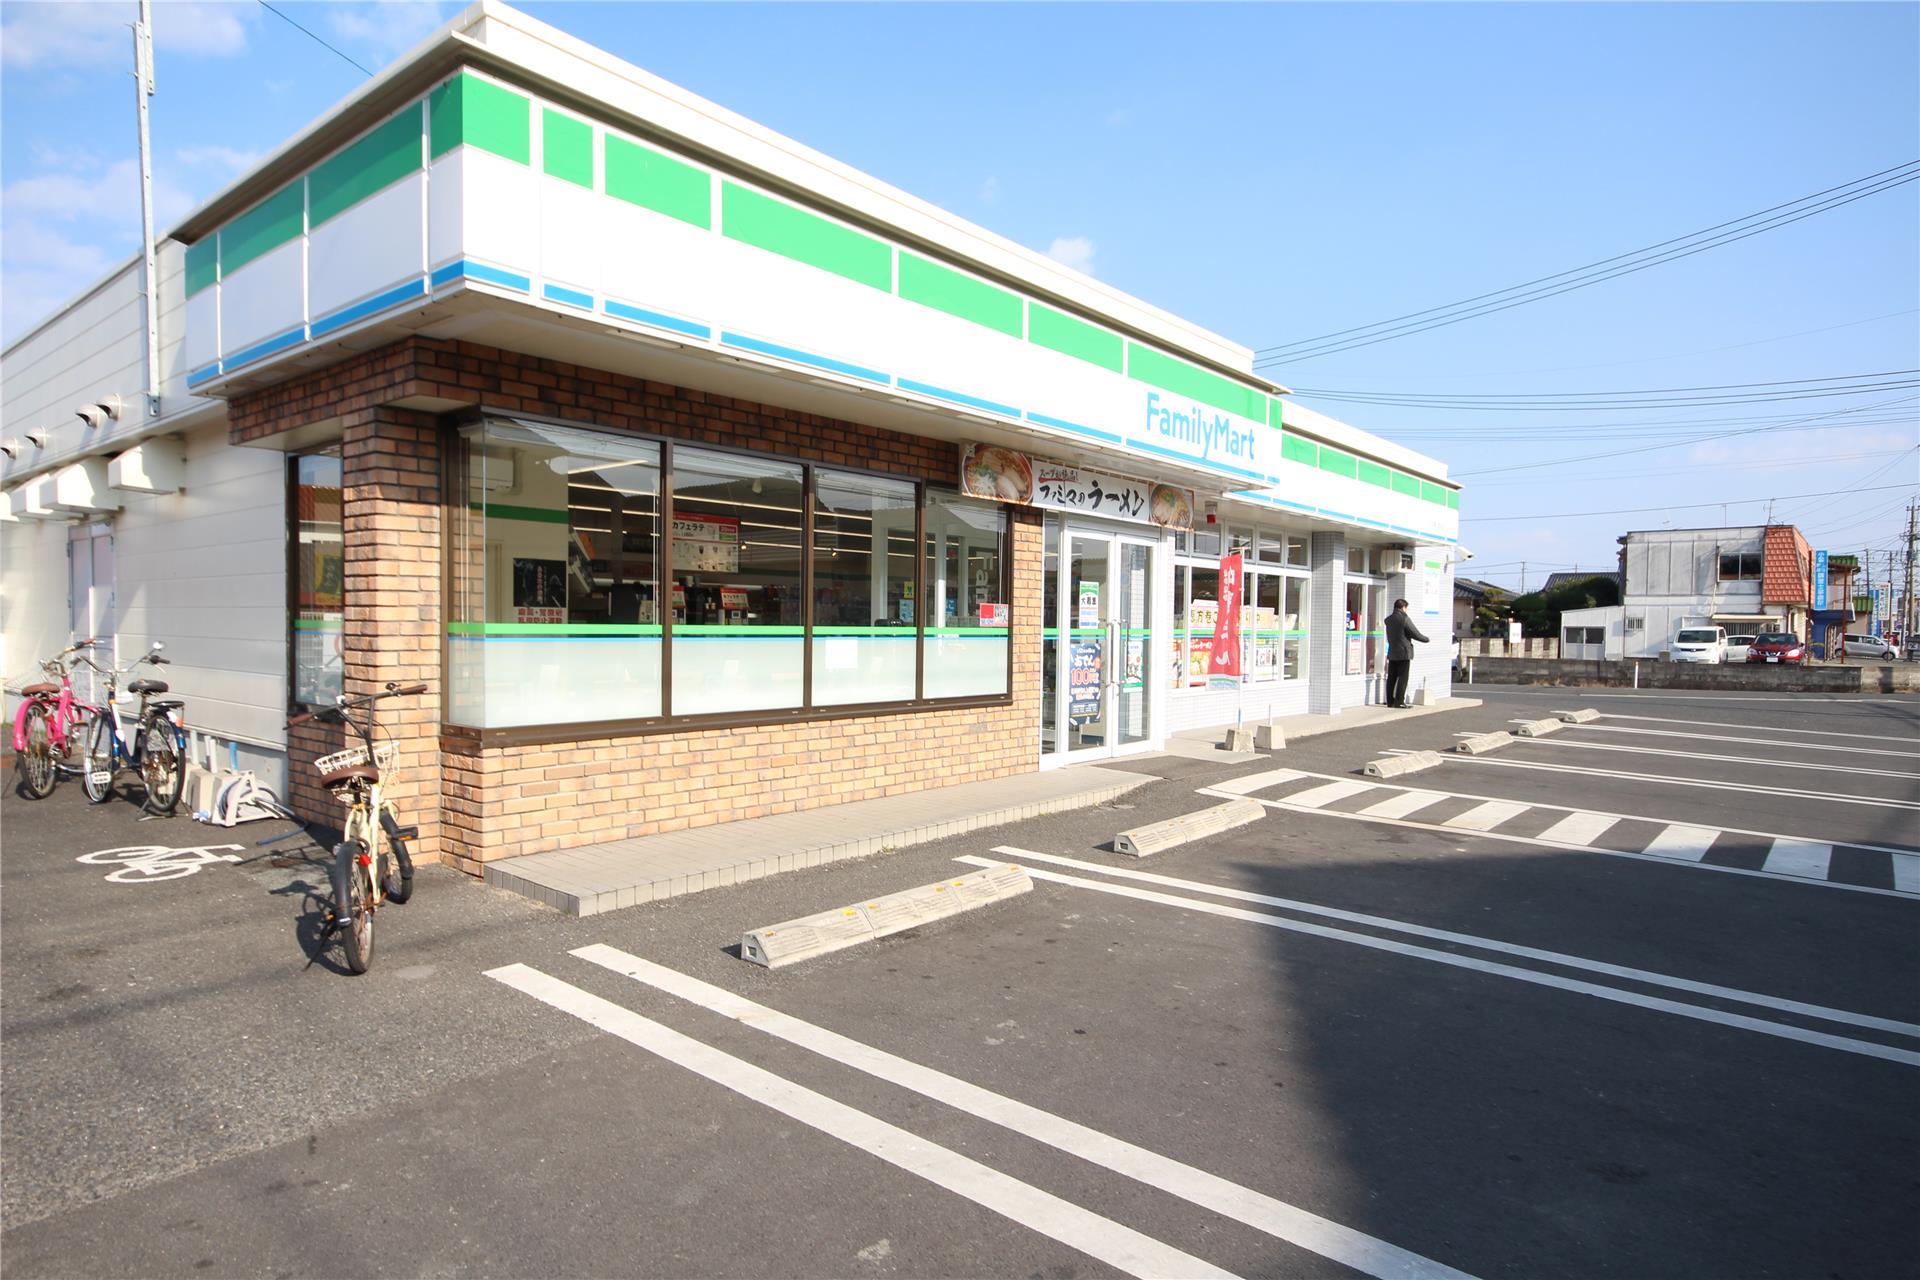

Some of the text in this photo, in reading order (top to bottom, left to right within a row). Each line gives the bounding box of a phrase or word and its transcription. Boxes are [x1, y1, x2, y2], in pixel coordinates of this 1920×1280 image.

[1146, 391, 1256, 460] FamilyMart
[1039, 479, 1145, 516] ファミマのラーメン
[672, 521, 705, 531] カフェラテ
